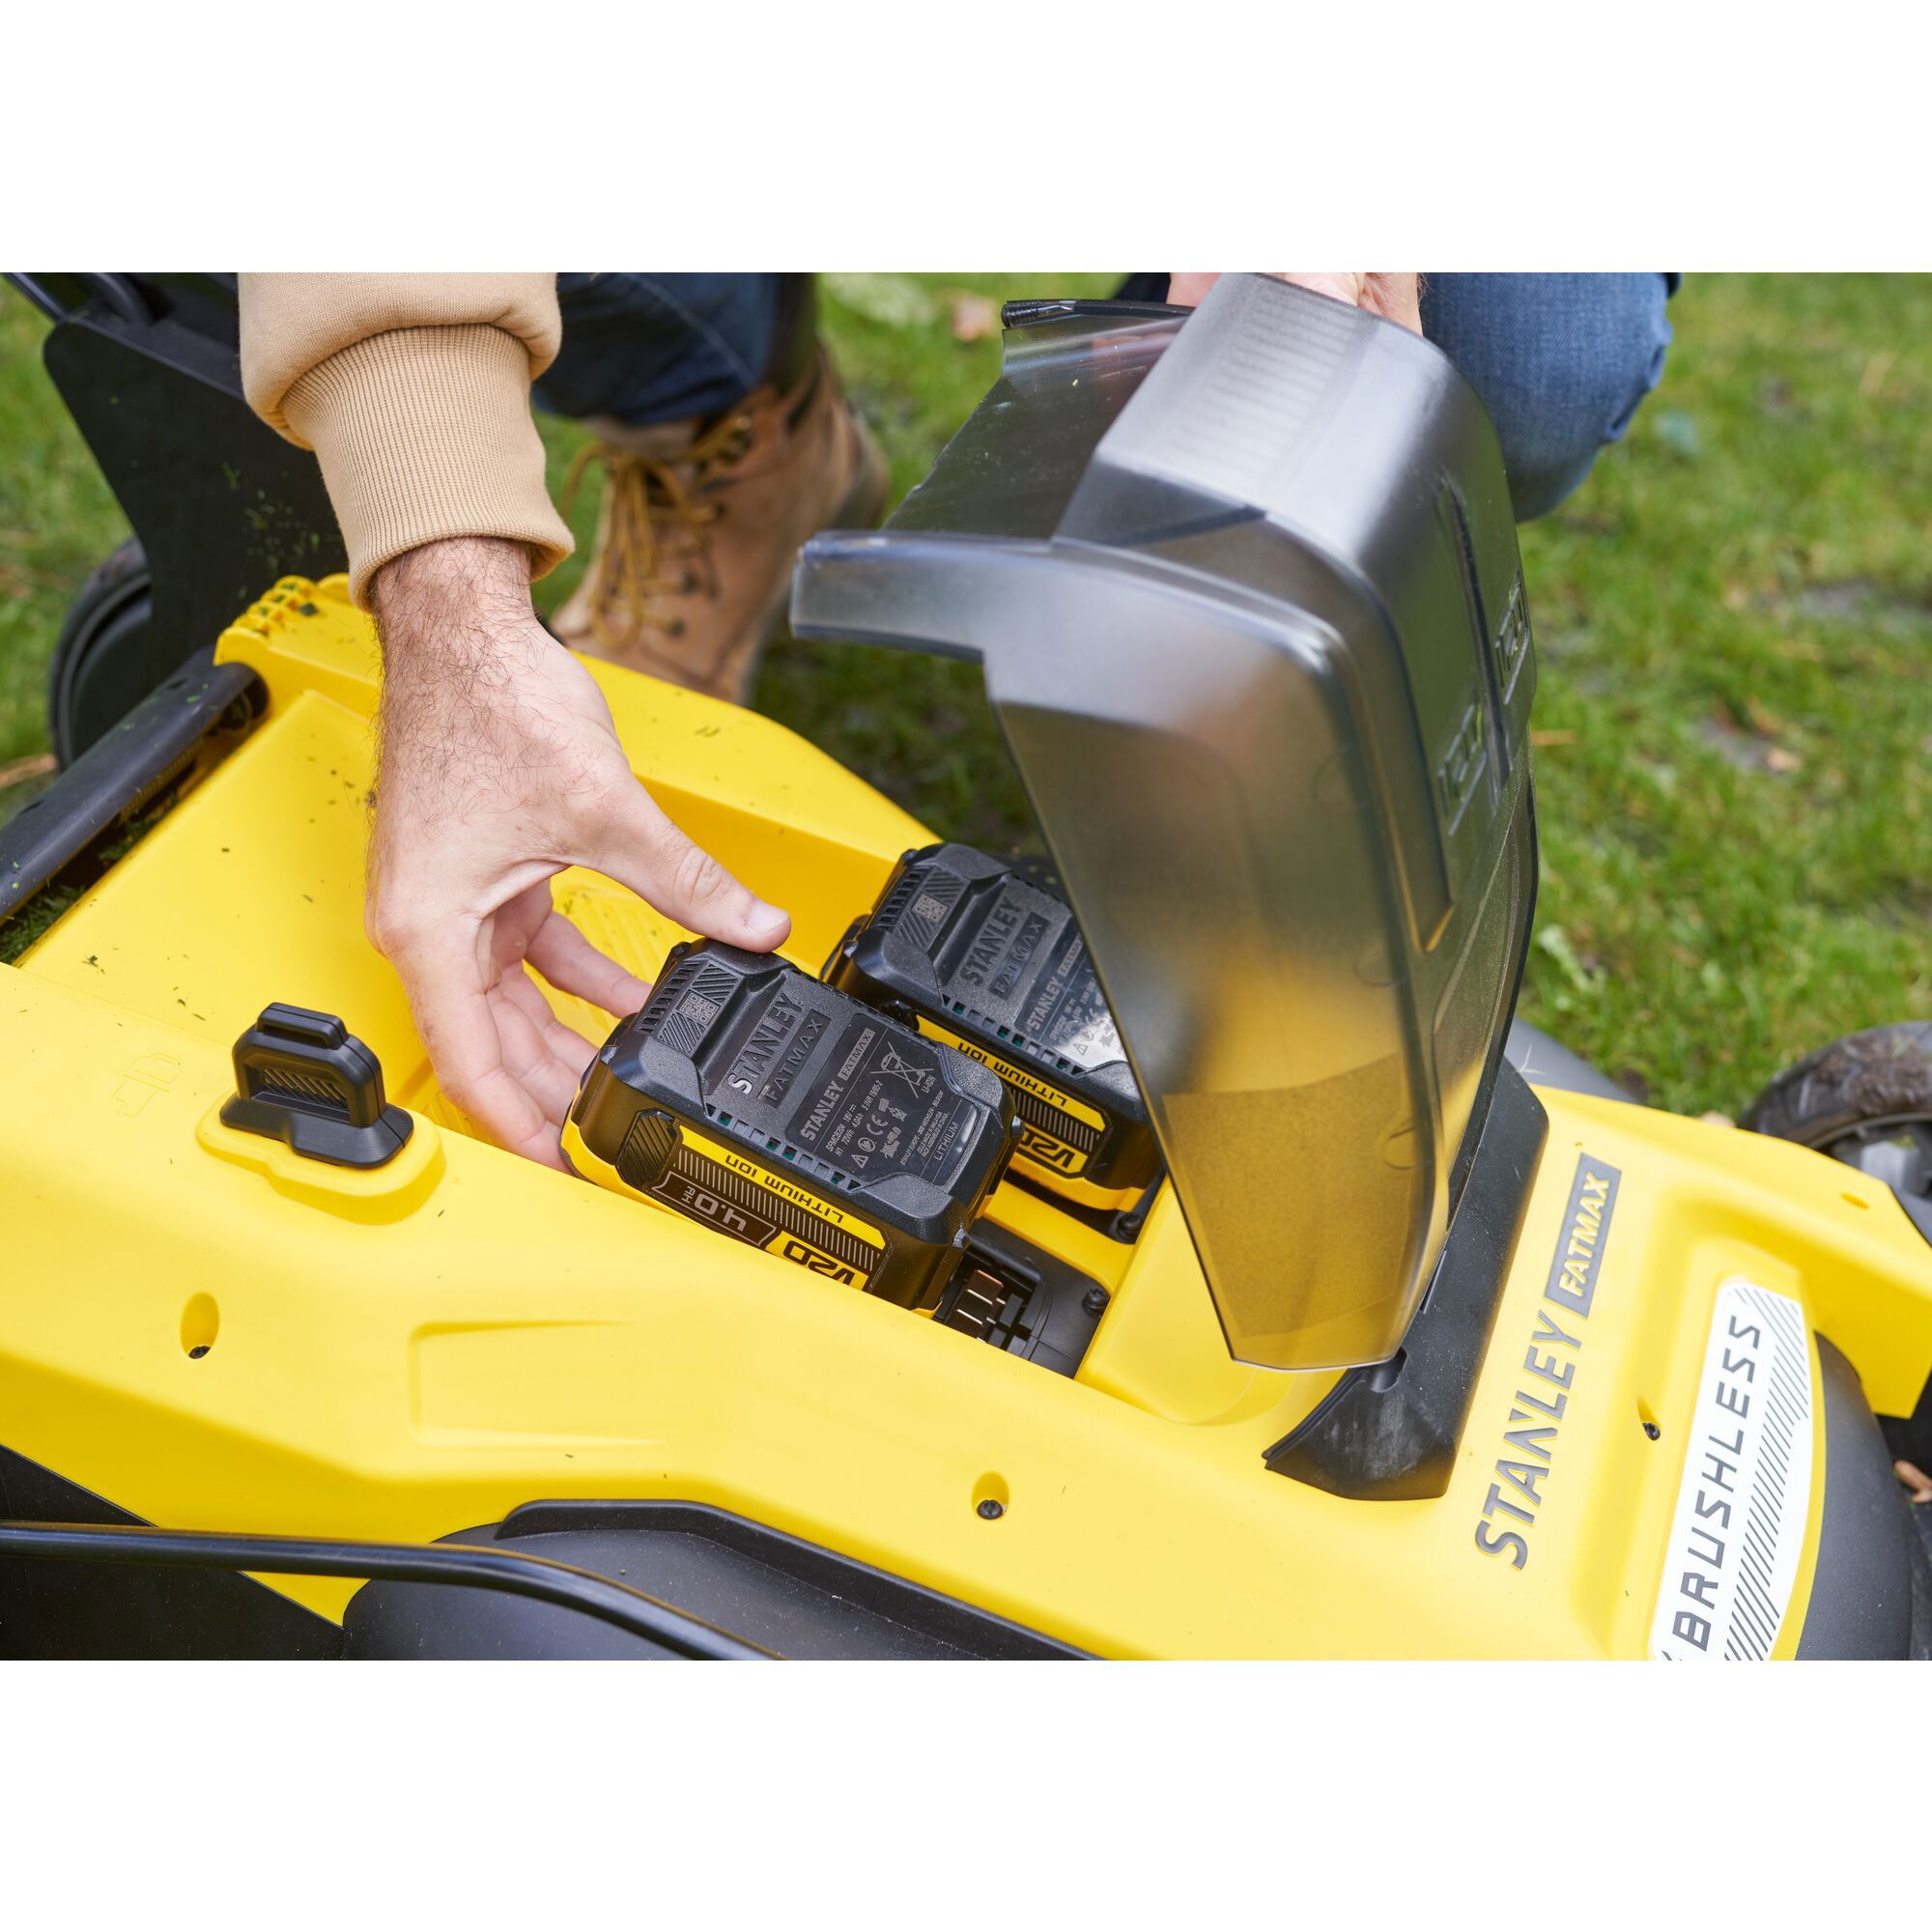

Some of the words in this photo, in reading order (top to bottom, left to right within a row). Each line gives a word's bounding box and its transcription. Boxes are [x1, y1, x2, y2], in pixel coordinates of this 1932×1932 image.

[960, 896, 1021, 985] STANLEY
[995, 921, 1043, 995] FATMAX
[1027, 976, 1062, 1030] STANLEY
[1060, 933, 1083, 975] FATMA
[727, 992, 803, 1095] STANLEY
[761, 1017, 823, 1102] FATMAX
[801, 1080, 843, 1141] STANLEY
[842, 1034, 871, 1076] FATMAX
[825, 1123, 846, 1151] SFMCB204
[843, 1111, 853, 1122] 18V
[835, 1147, 844, 1157] H1
[841, 1129, 855, 1146] 72Wh
[852, 1113, 865, 1128] 4.0Ah
[933, 1121, 959, 1161] LITHIUM
[694, 1193, 747, 1232] 4.0
[1474, 1309, 1582, 1571] STANLEY
[1558, 1172, 1610, 1298] FATMAX
[1672, 1315, 1761, 1652] BRUSHLESS
